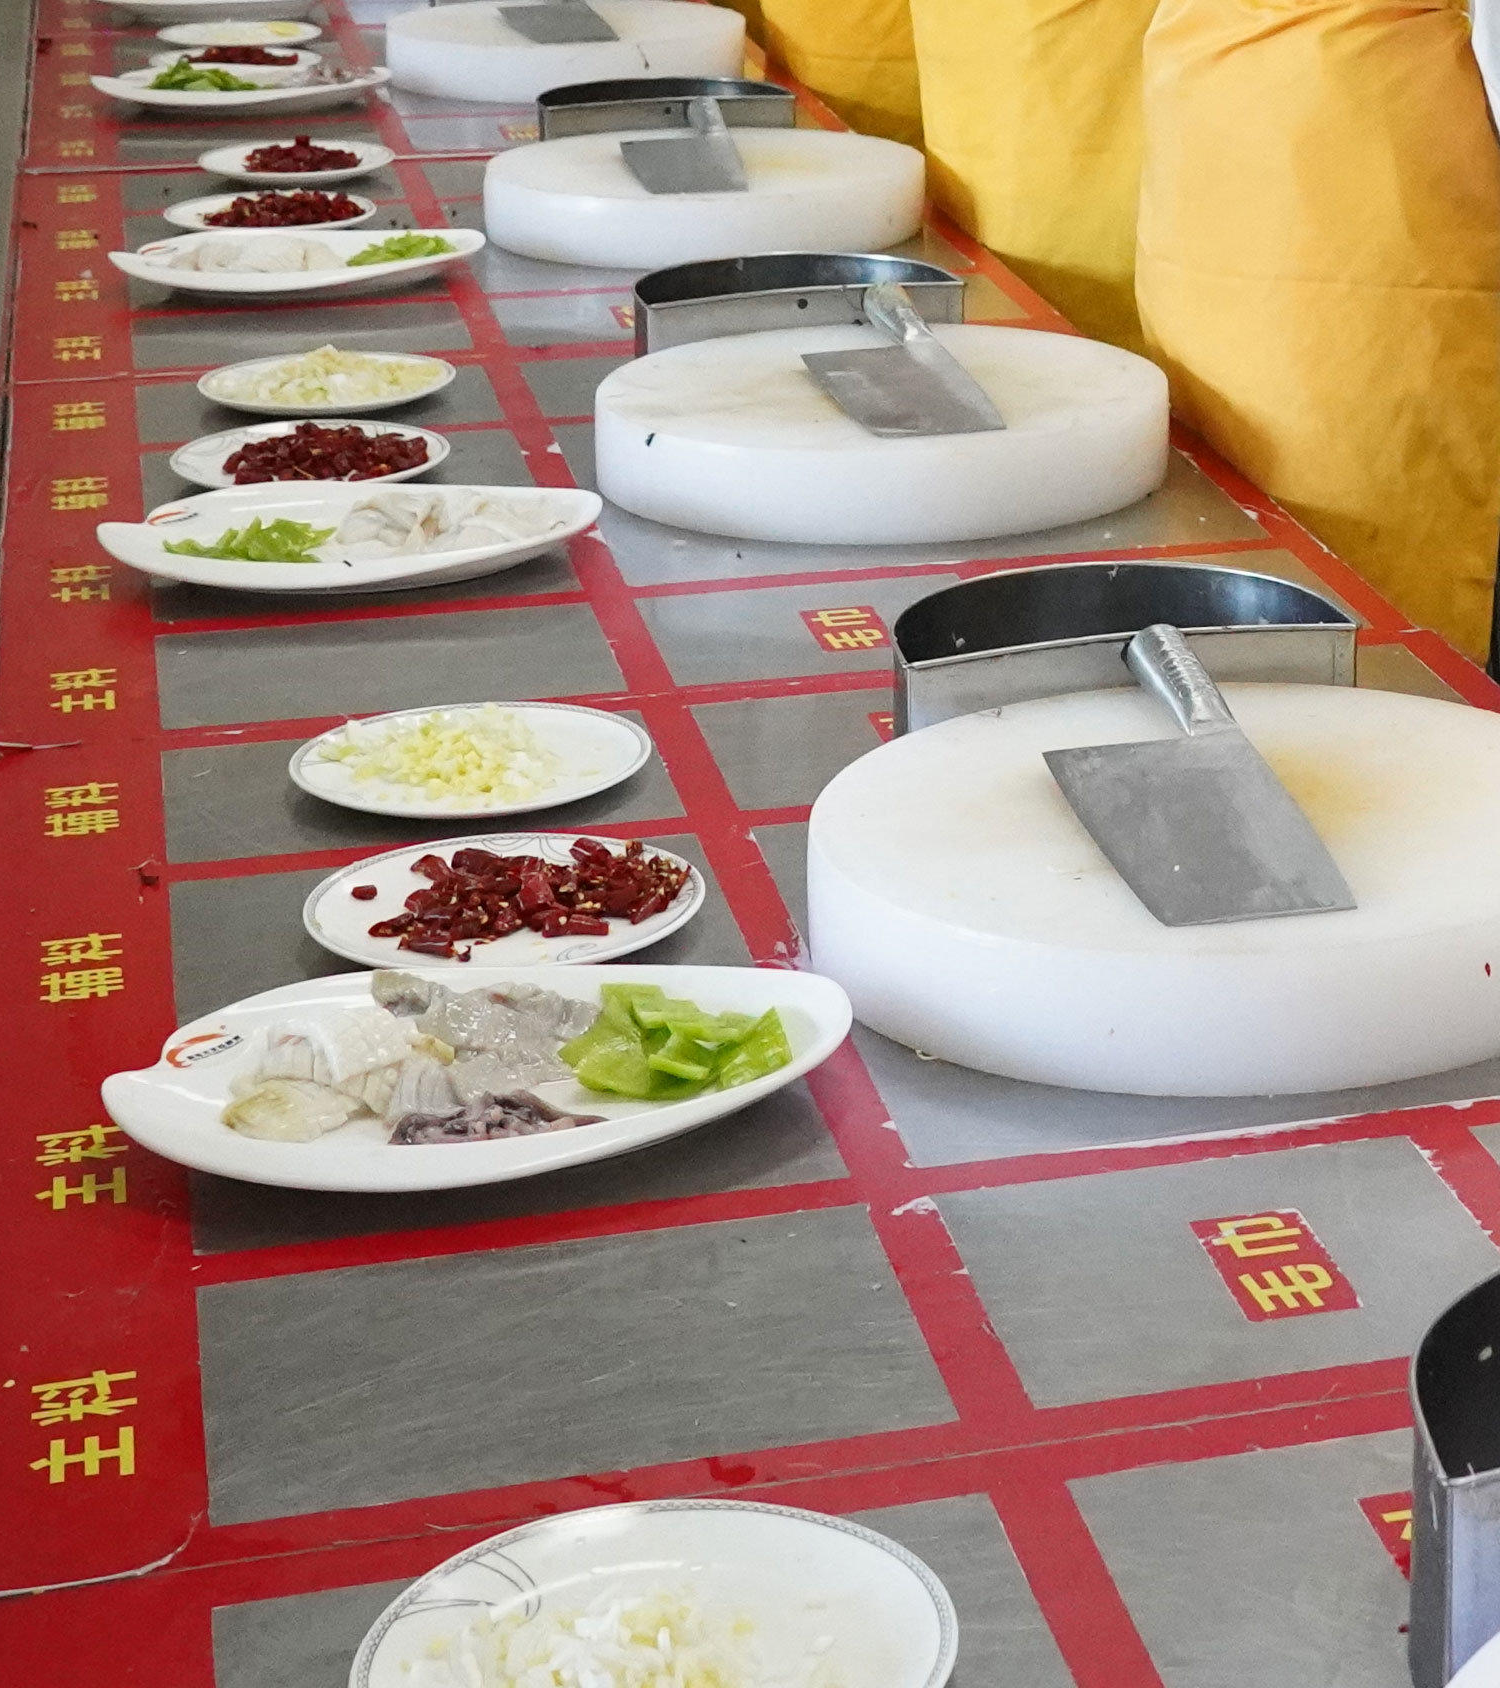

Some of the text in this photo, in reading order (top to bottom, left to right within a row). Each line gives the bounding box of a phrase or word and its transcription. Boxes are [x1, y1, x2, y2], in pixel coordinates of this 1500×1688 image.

[50, 565, 112, 603] 主料
[812, 608, 883, 650] 毛巾
[50, 668, 117, 714] 主料
[44, 781, 120, 838] 辅料
[39, 932, 124, 1004] 辅料
[35, 1123, 128, 1210] 主料
[1211, 1216, 1334, 1313] 毛巾
[30, 1368, 138, 1484] 主料
